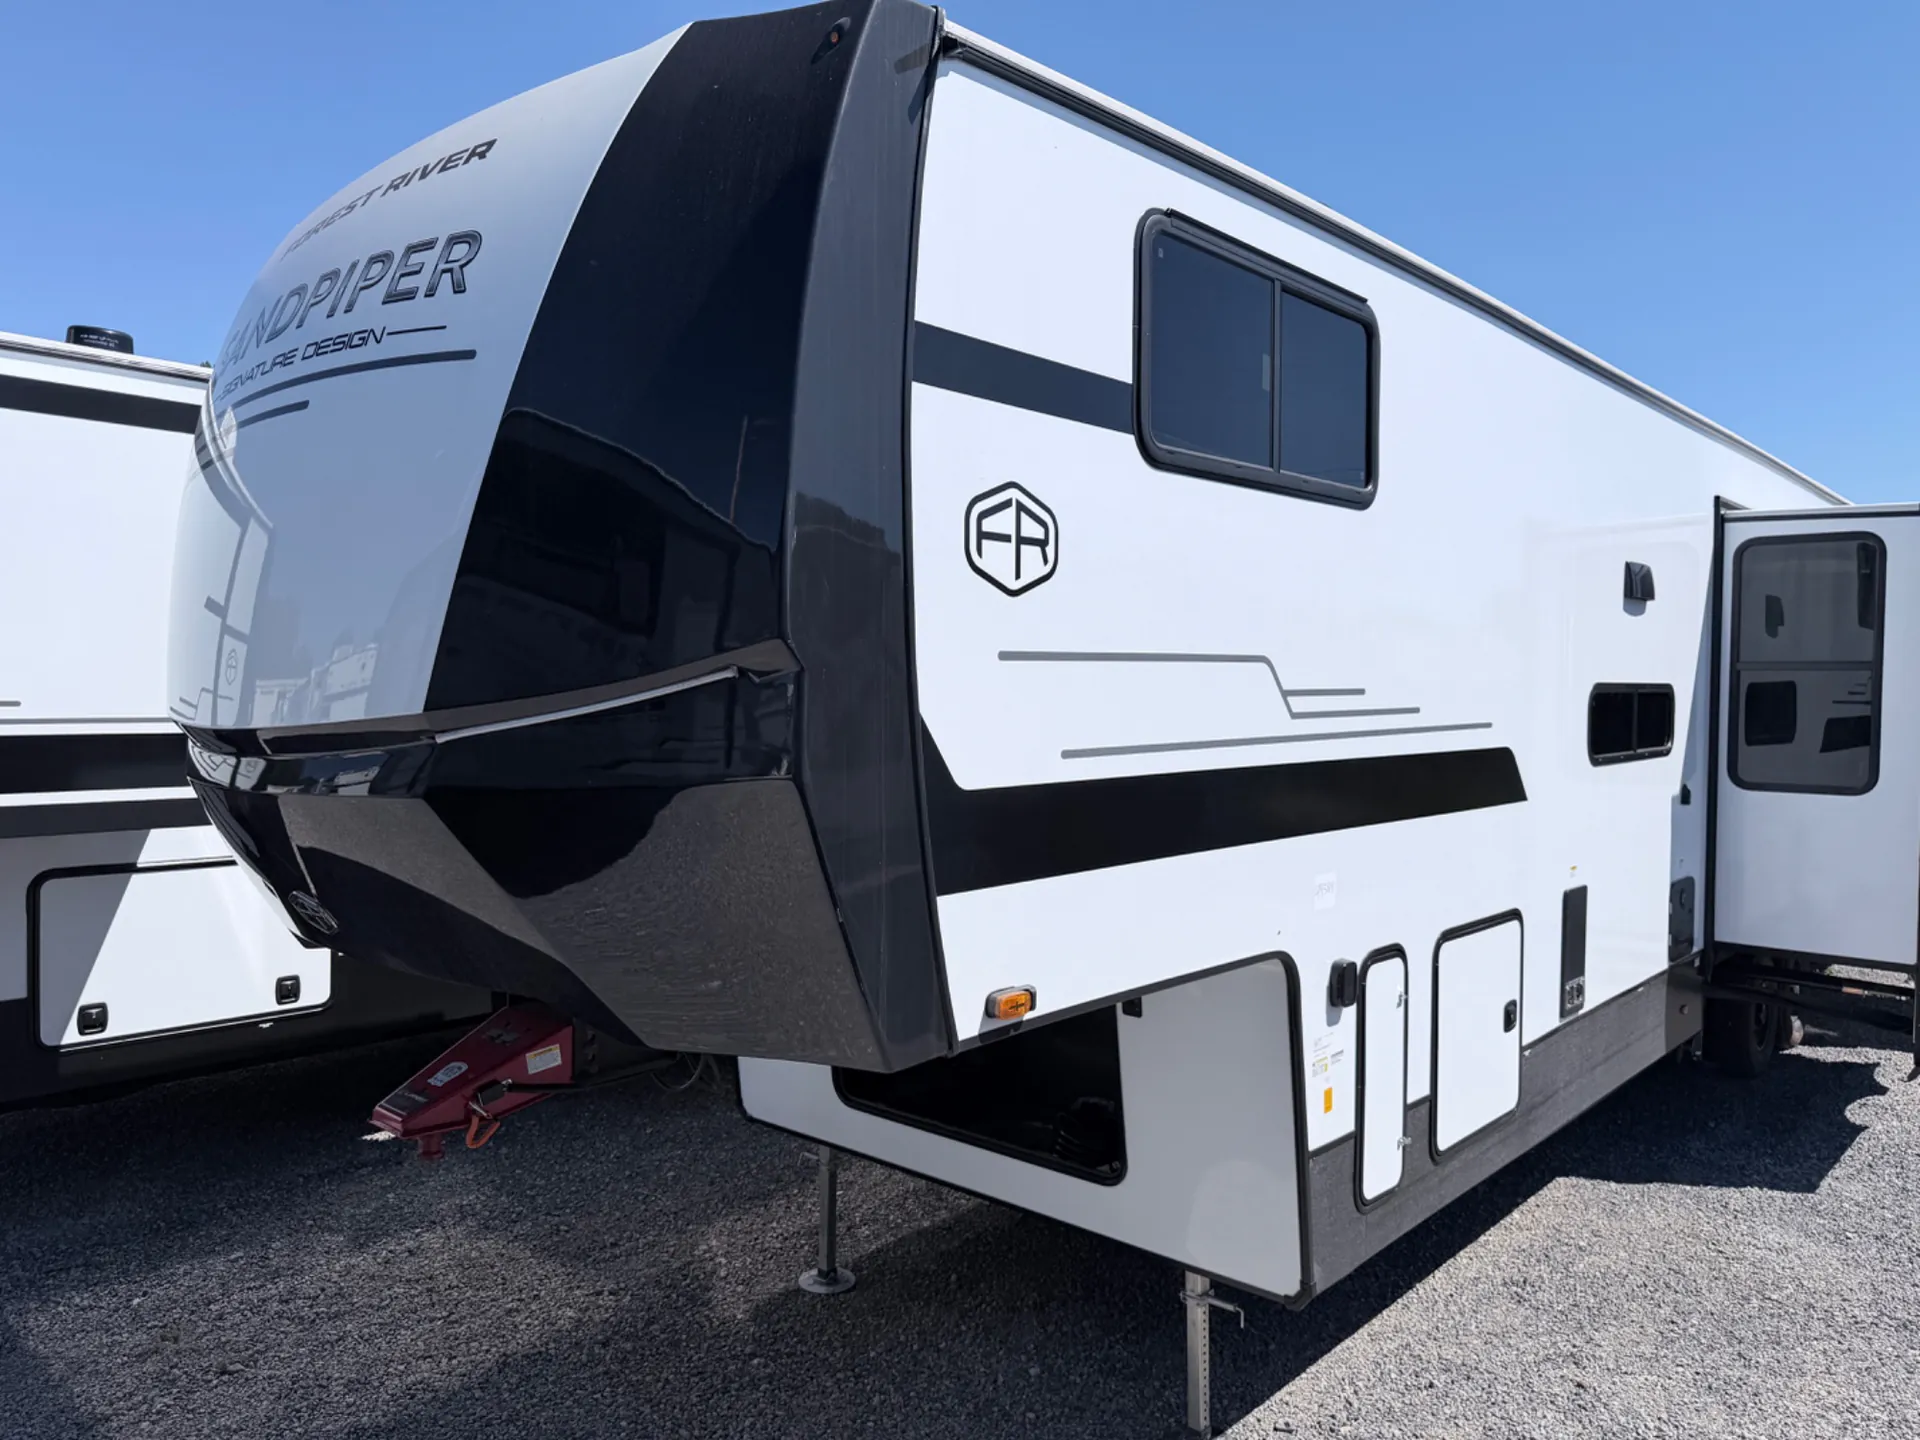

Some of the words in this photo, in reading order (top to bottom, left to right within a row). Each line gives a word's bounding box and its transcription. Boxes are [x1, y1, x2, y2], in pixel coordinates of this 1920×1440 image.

[380, 138, 497, 197] RIVER
[219, 229, 483, 377] SANDPIPER
[301, 326, 386, 362] DESIGN
